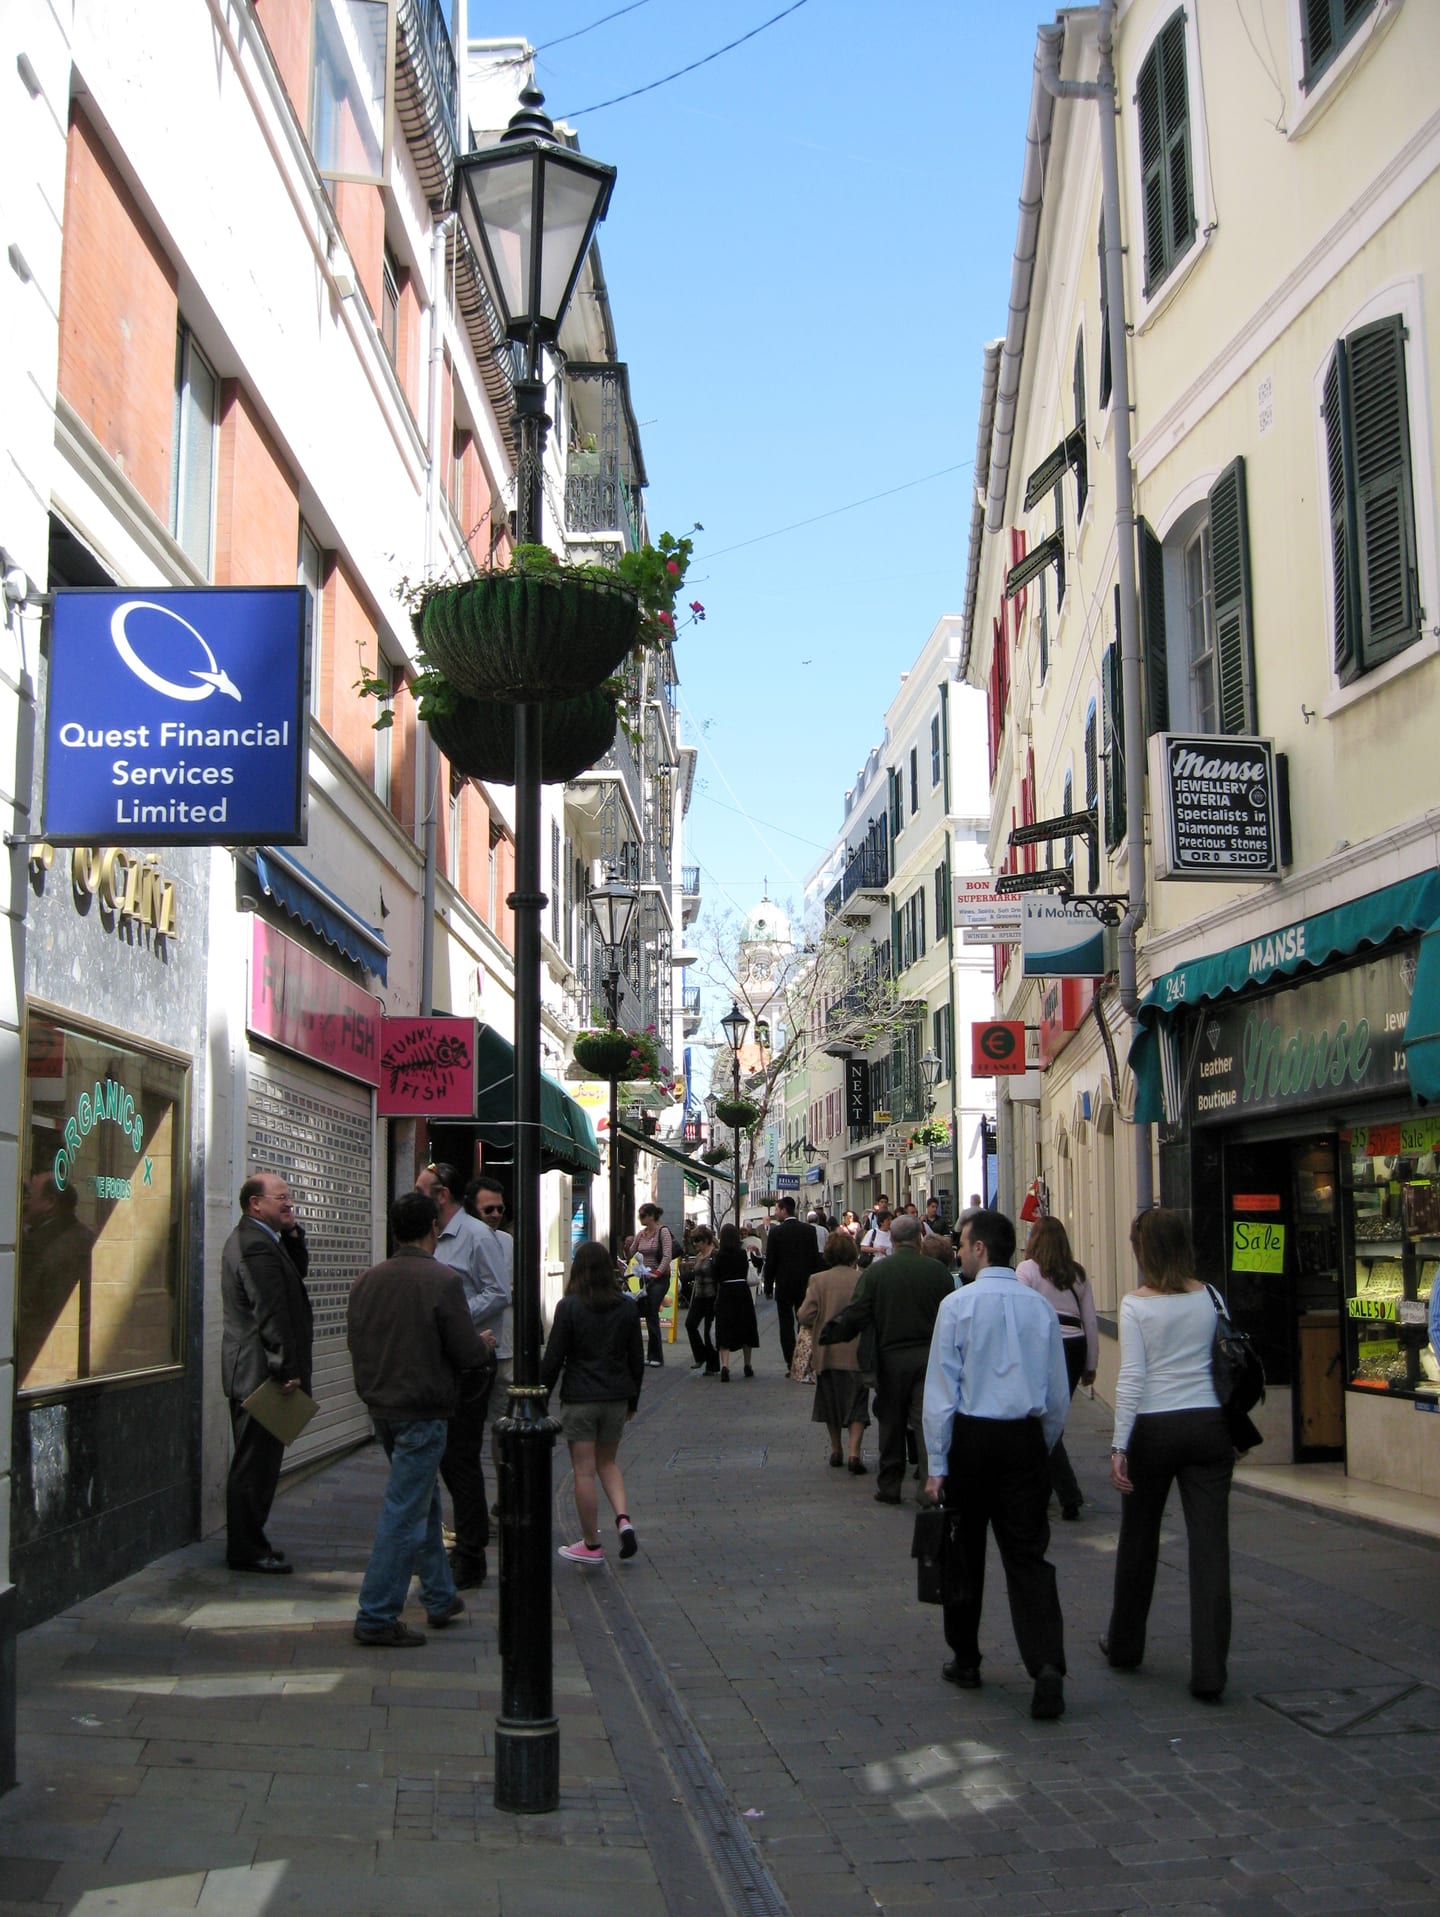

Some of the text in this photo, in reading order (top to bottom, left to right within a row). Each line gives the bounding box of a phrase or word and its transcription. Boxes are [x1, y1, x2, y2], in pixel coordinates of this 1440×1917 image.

[59, 720, 289, 748] Quest Financial
[112, 760, 235, 785] Services
[1173, 749, 1265, 781] Manse
[1175, 780, 1248, 794] JEWELLERY
[117, 797, 227, 823] Limited
[1176, 792, 1231, 806] JOYERIA
[1177, 808, 1266, 822] Specialists in
[1178, 822, 1267, 836] Diamonds and
[1179, 837, 1268, 850] Precious Stones
[1230, 852, 1268, 863] SHOP
[966, 881, 990, 890] BON
[958, 893, 1022, 903] SUPERMARKE
[1045, 906, 1099, 919] Monarc
[1249, 926, 1306, 975] MANSE
[1166, 973, 1187, 1003] 245
[341, 1004, 376, 1061] FISH
[1384, 1011, 1408, 1033] Jew
[384, 1026, 433, 1063] FUNKY
[1200, 1056, 1233, 1079] Leather
[1243, 1010, 1372, 1103] Manse
[1393, 1051, 1407, 1072] Jo
[401, 1083, 447, 1101] FISH
[851, 1066, 864, 1120] NEXT
[1198, 1089, 1237, 1111] Boutique
[54, 1079, 144, 1192] ORGANICS
[1401, 1128, 1425, 1149] Sale
[105, 1177, 132, 1200] FOODS
[1235, 1222, 1281, 1250] Sale
[1350, 1300, 1372, 1317] SALE
[1373, 1302, 1393, 1319] 50%
